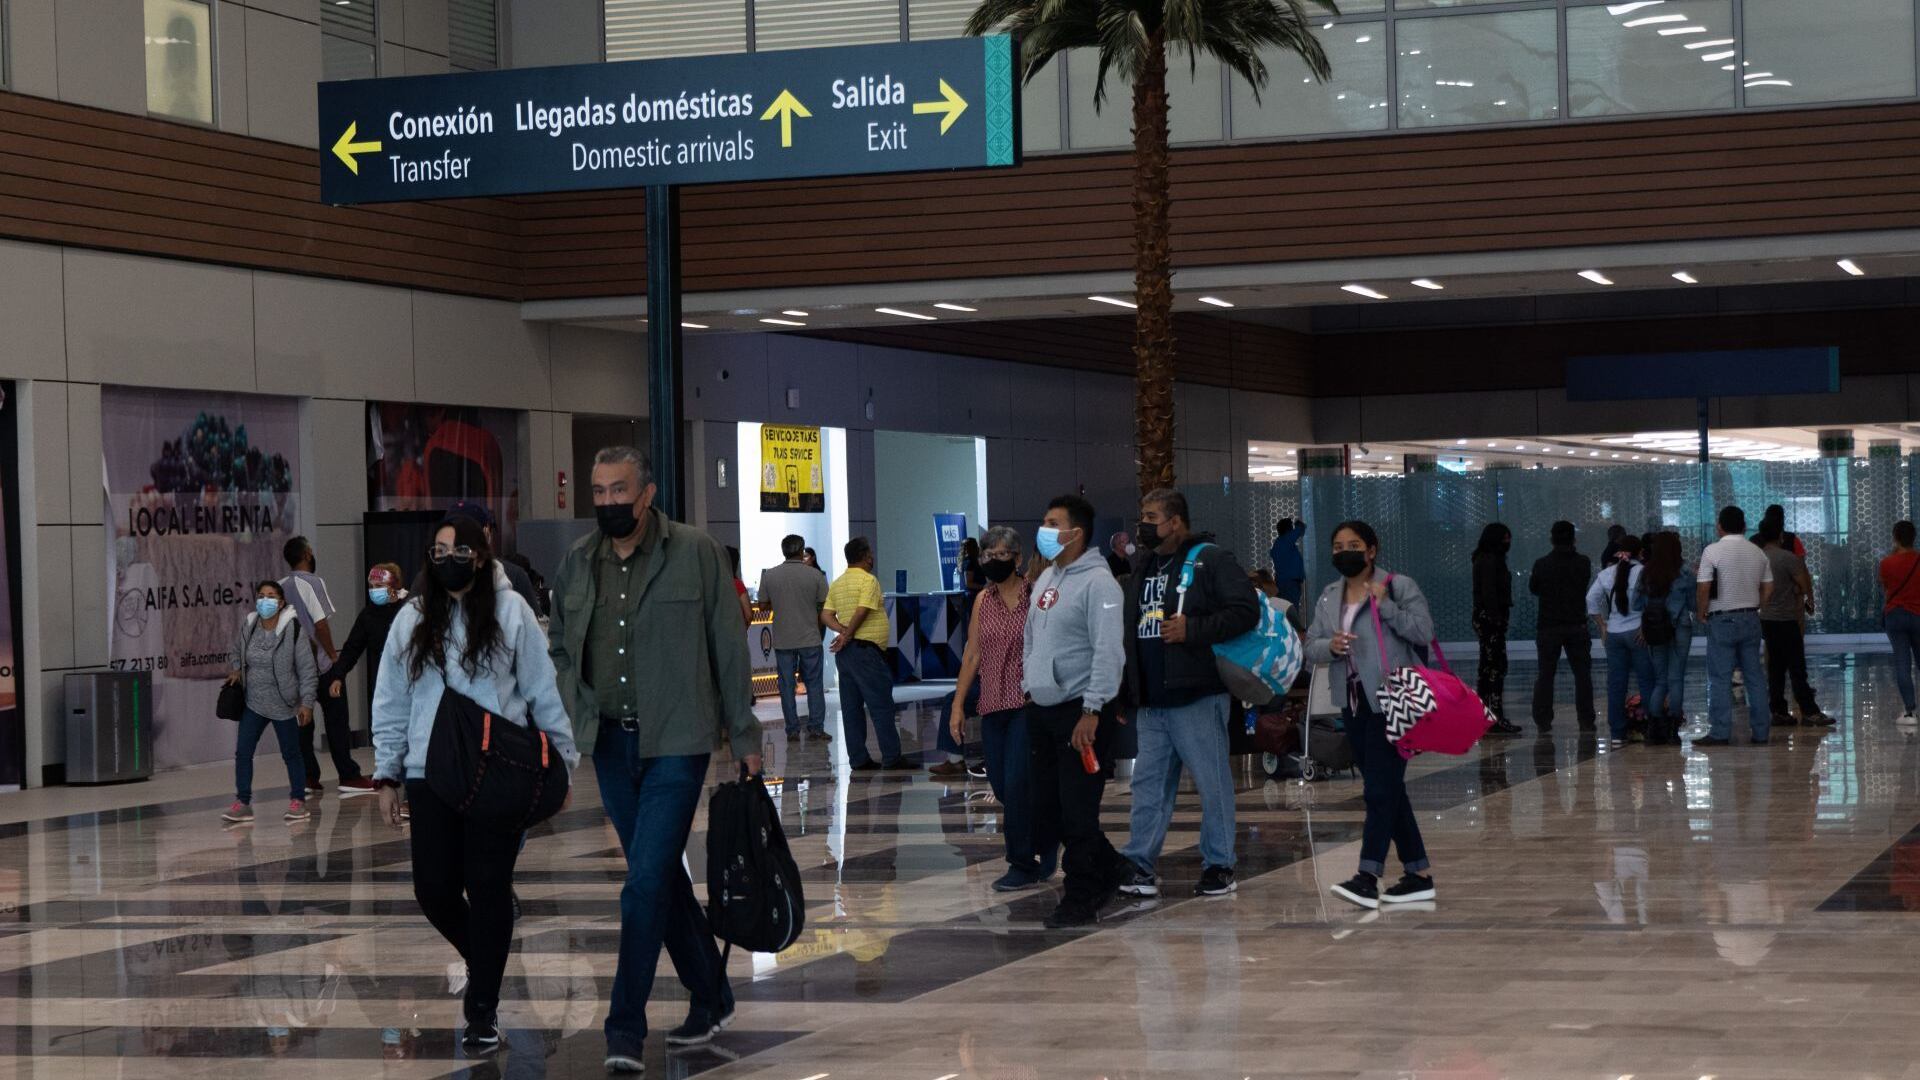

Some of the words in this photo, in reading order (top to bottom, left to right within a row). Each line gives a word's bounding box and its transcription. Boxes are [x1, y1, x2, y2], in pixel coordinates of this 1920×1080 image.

[832, 74, 905, 110] Salida
[389, 106, 493, 140] Conexión
[515, 96, 616, 137] Llegadas
[622, 89, 753, 124] domésticas
[572, 138, 672, 171] Domestic
[677, 130, 754, 165] arrivals
[867, 121, 908, 151] Exit
[389, 149, 471, 184] Transfer
[128, 506, 189, 537] LOCAL
[194, 505, 216, 534] EN
[145, 584, 178, 611] AIFA
[182, 584, 209, 608] S.A.
[213, 583, 234, 605] de
[131, 658, 142, 671] 21
[145, 657, 155, 670] 31
[158, 656, 168, 670] 80
